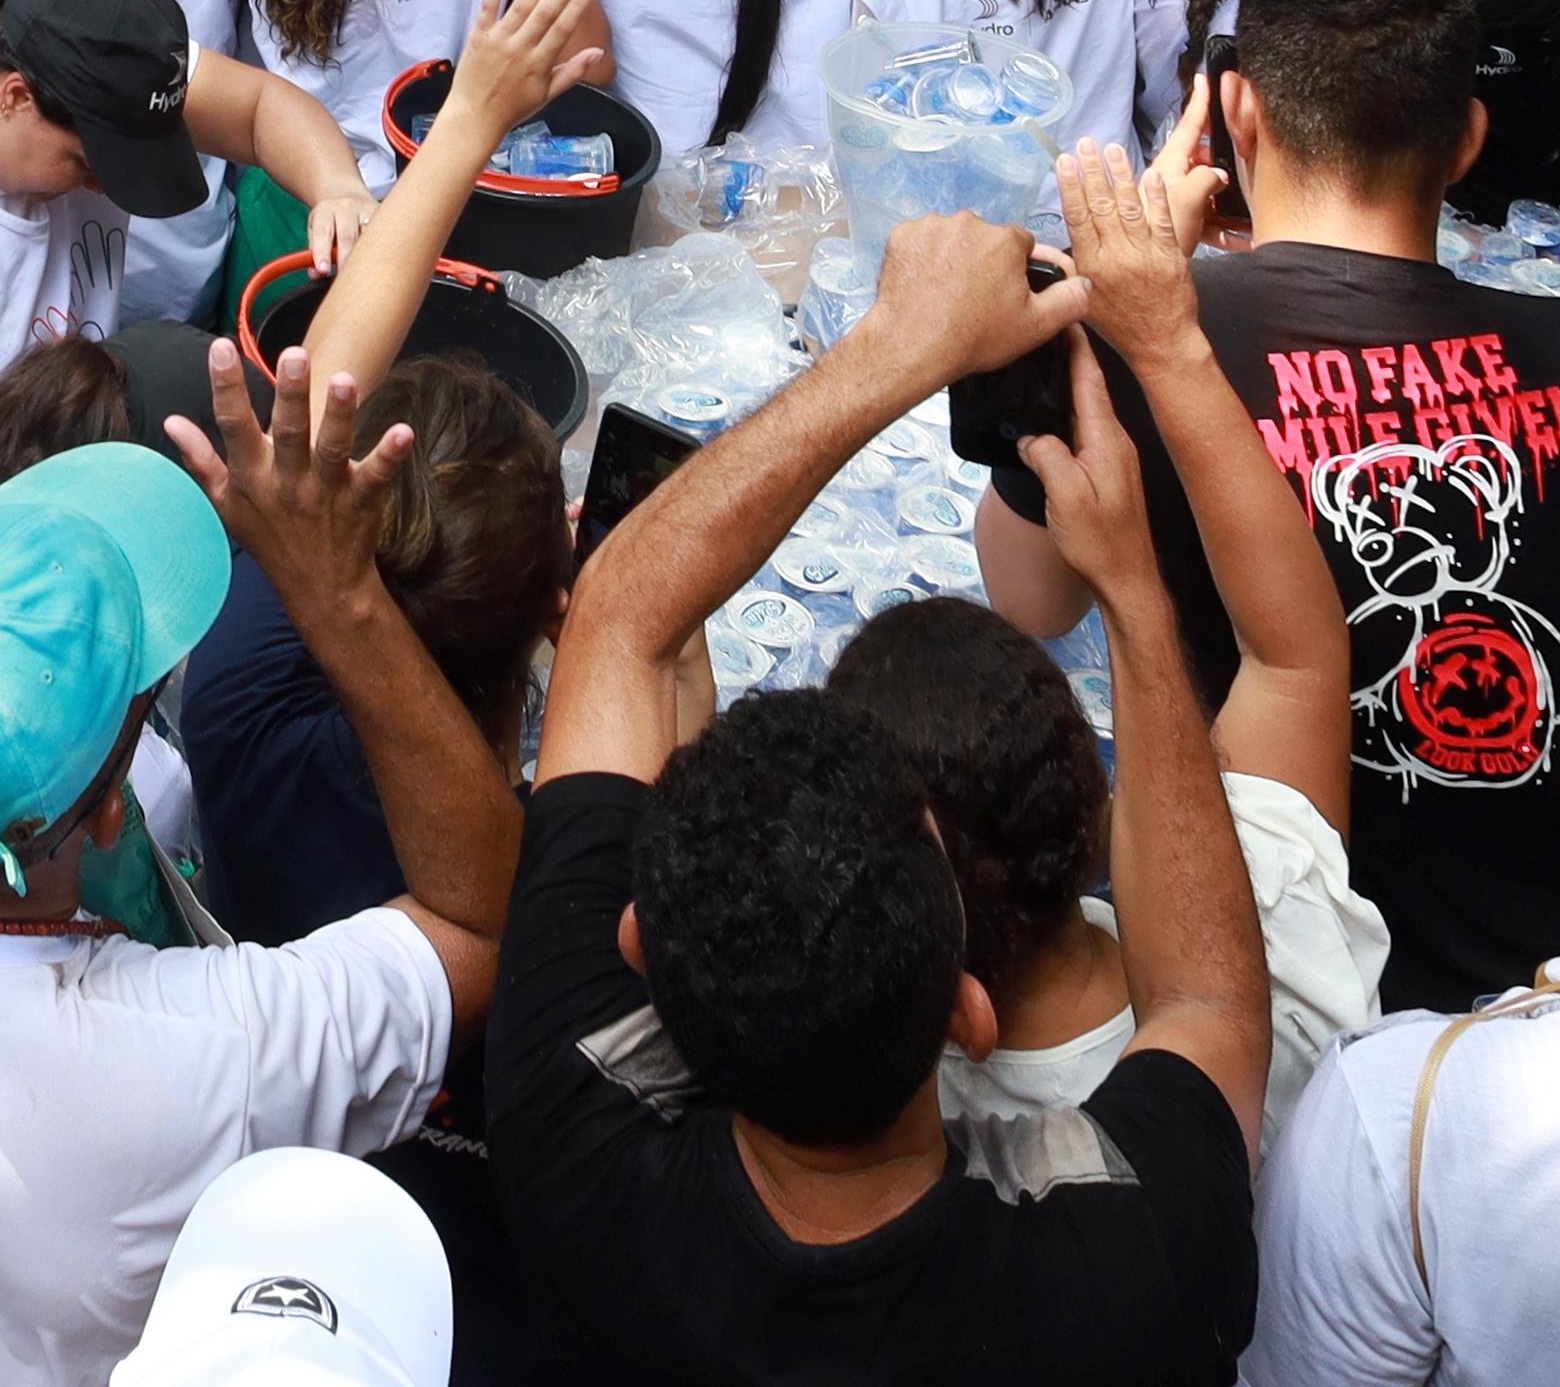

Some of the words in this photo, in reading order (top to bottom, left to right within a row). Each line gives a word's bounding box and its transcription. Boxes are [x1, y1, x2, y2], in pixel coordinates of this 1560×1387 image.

[1476, 63, 1523, 76] Hydro
[1266, 349, 1358, 417] NO
[1361, 332, 1520, 405] FAKE
